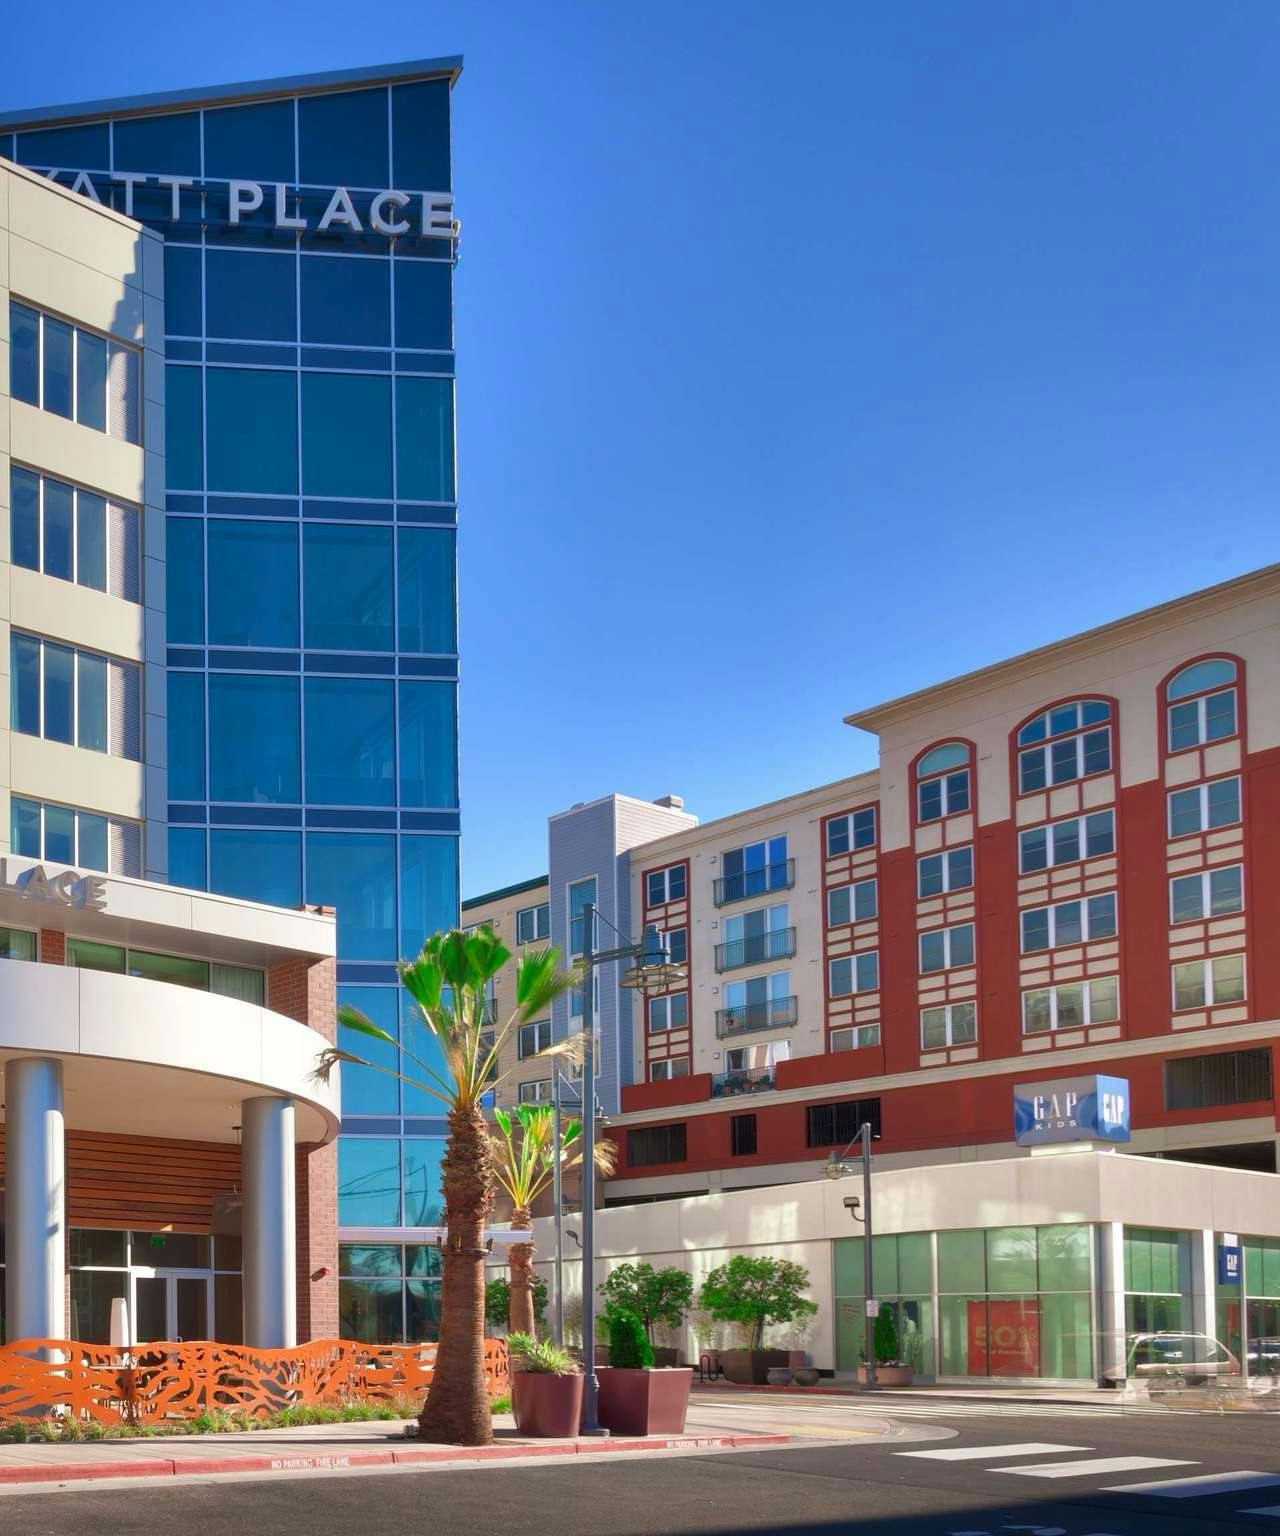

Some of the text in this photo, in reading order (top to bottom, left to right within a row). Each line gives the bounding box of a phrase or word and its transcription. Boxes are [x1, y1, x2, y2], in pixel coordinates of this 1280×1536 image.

[228, 180, 454, 238] PLACE
[1033, 1092, 1077, 1120] GAP
[1103, 1093, 1124, 1124] GAP
[1035, 1120, 1077, 1130] KIDS
[272, 1457, 350, 1469] NO PARKING FIRE LANE
